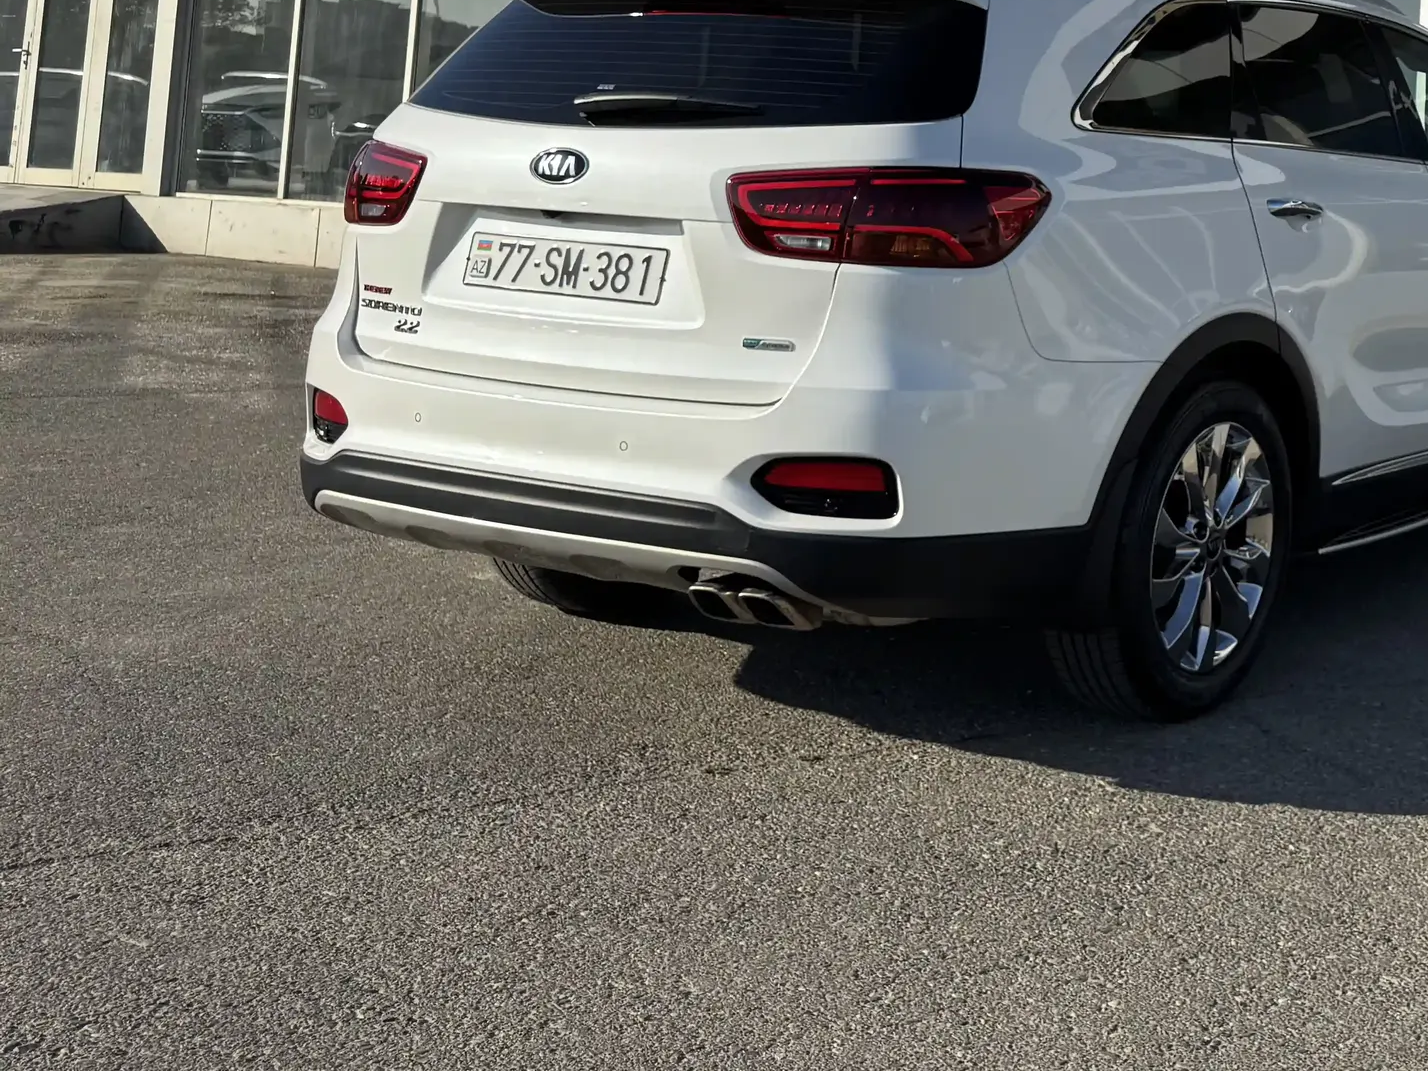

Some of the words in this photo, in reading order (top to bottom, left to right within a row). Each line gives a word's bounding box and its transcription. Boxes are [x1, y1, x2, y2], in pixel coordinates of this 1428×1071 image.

[538, 154, 576, 176] KIA
[470, 260, 486, 275] AZ
[492, 240, 653, 297] 77-SM-381
